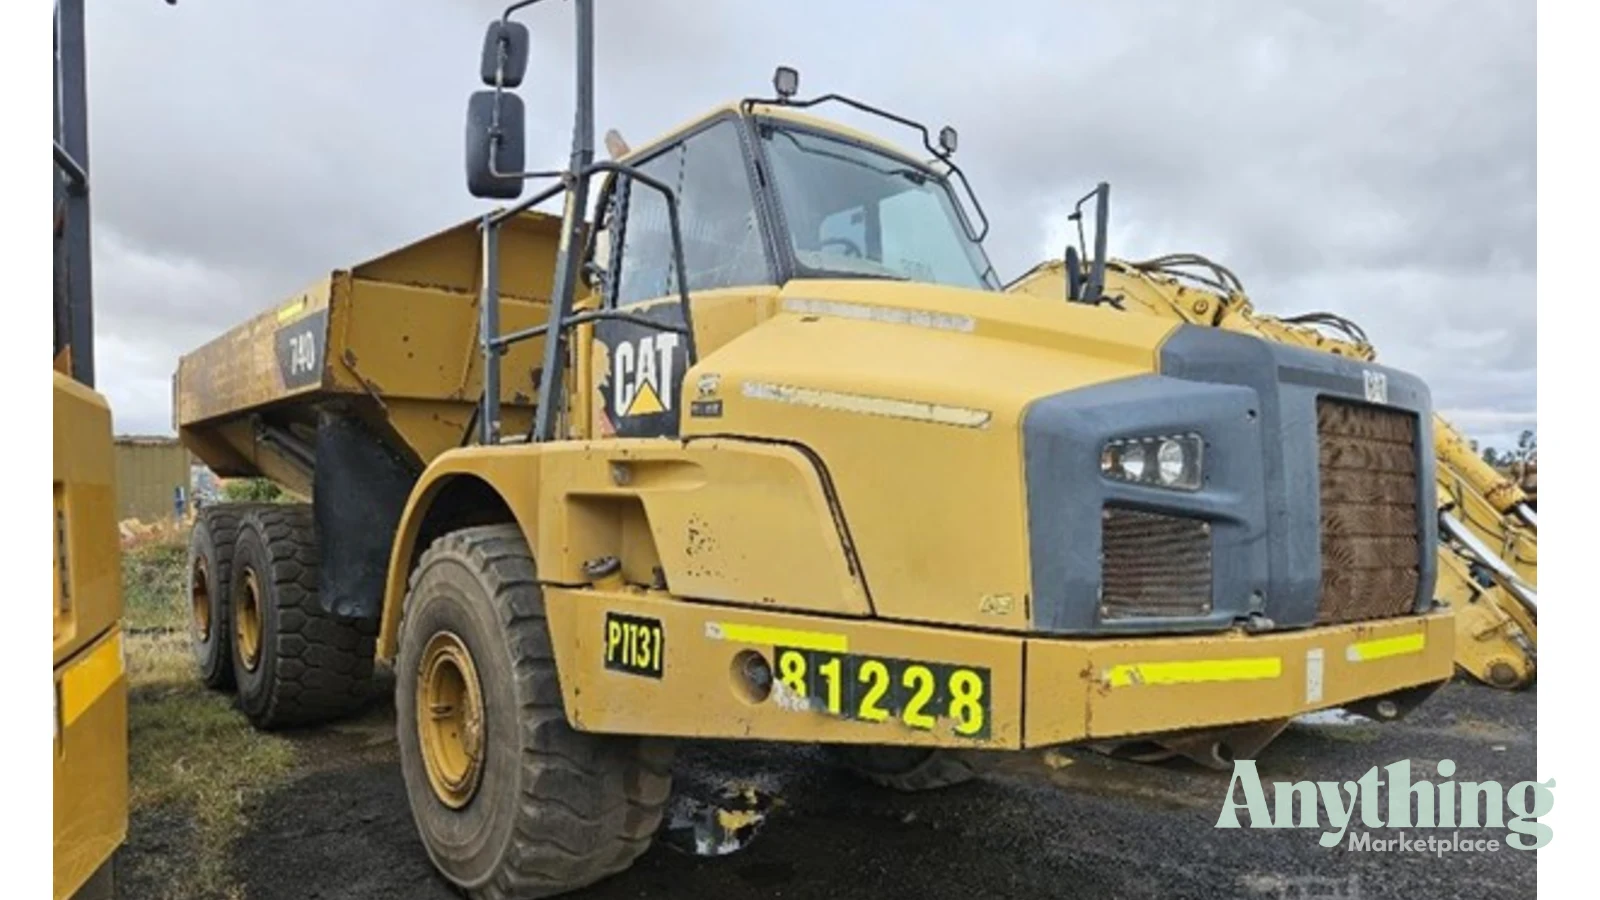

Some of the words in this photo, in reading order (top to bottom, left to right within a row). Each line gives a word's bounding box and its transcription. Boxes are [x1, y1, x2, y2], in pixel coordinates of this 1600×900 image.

[289, 330, 315, 377] 740
[615, 332, 678, 416] CAT
[608, 621, 660, 671] P1131
[779, 651, 983, 734] 81228
